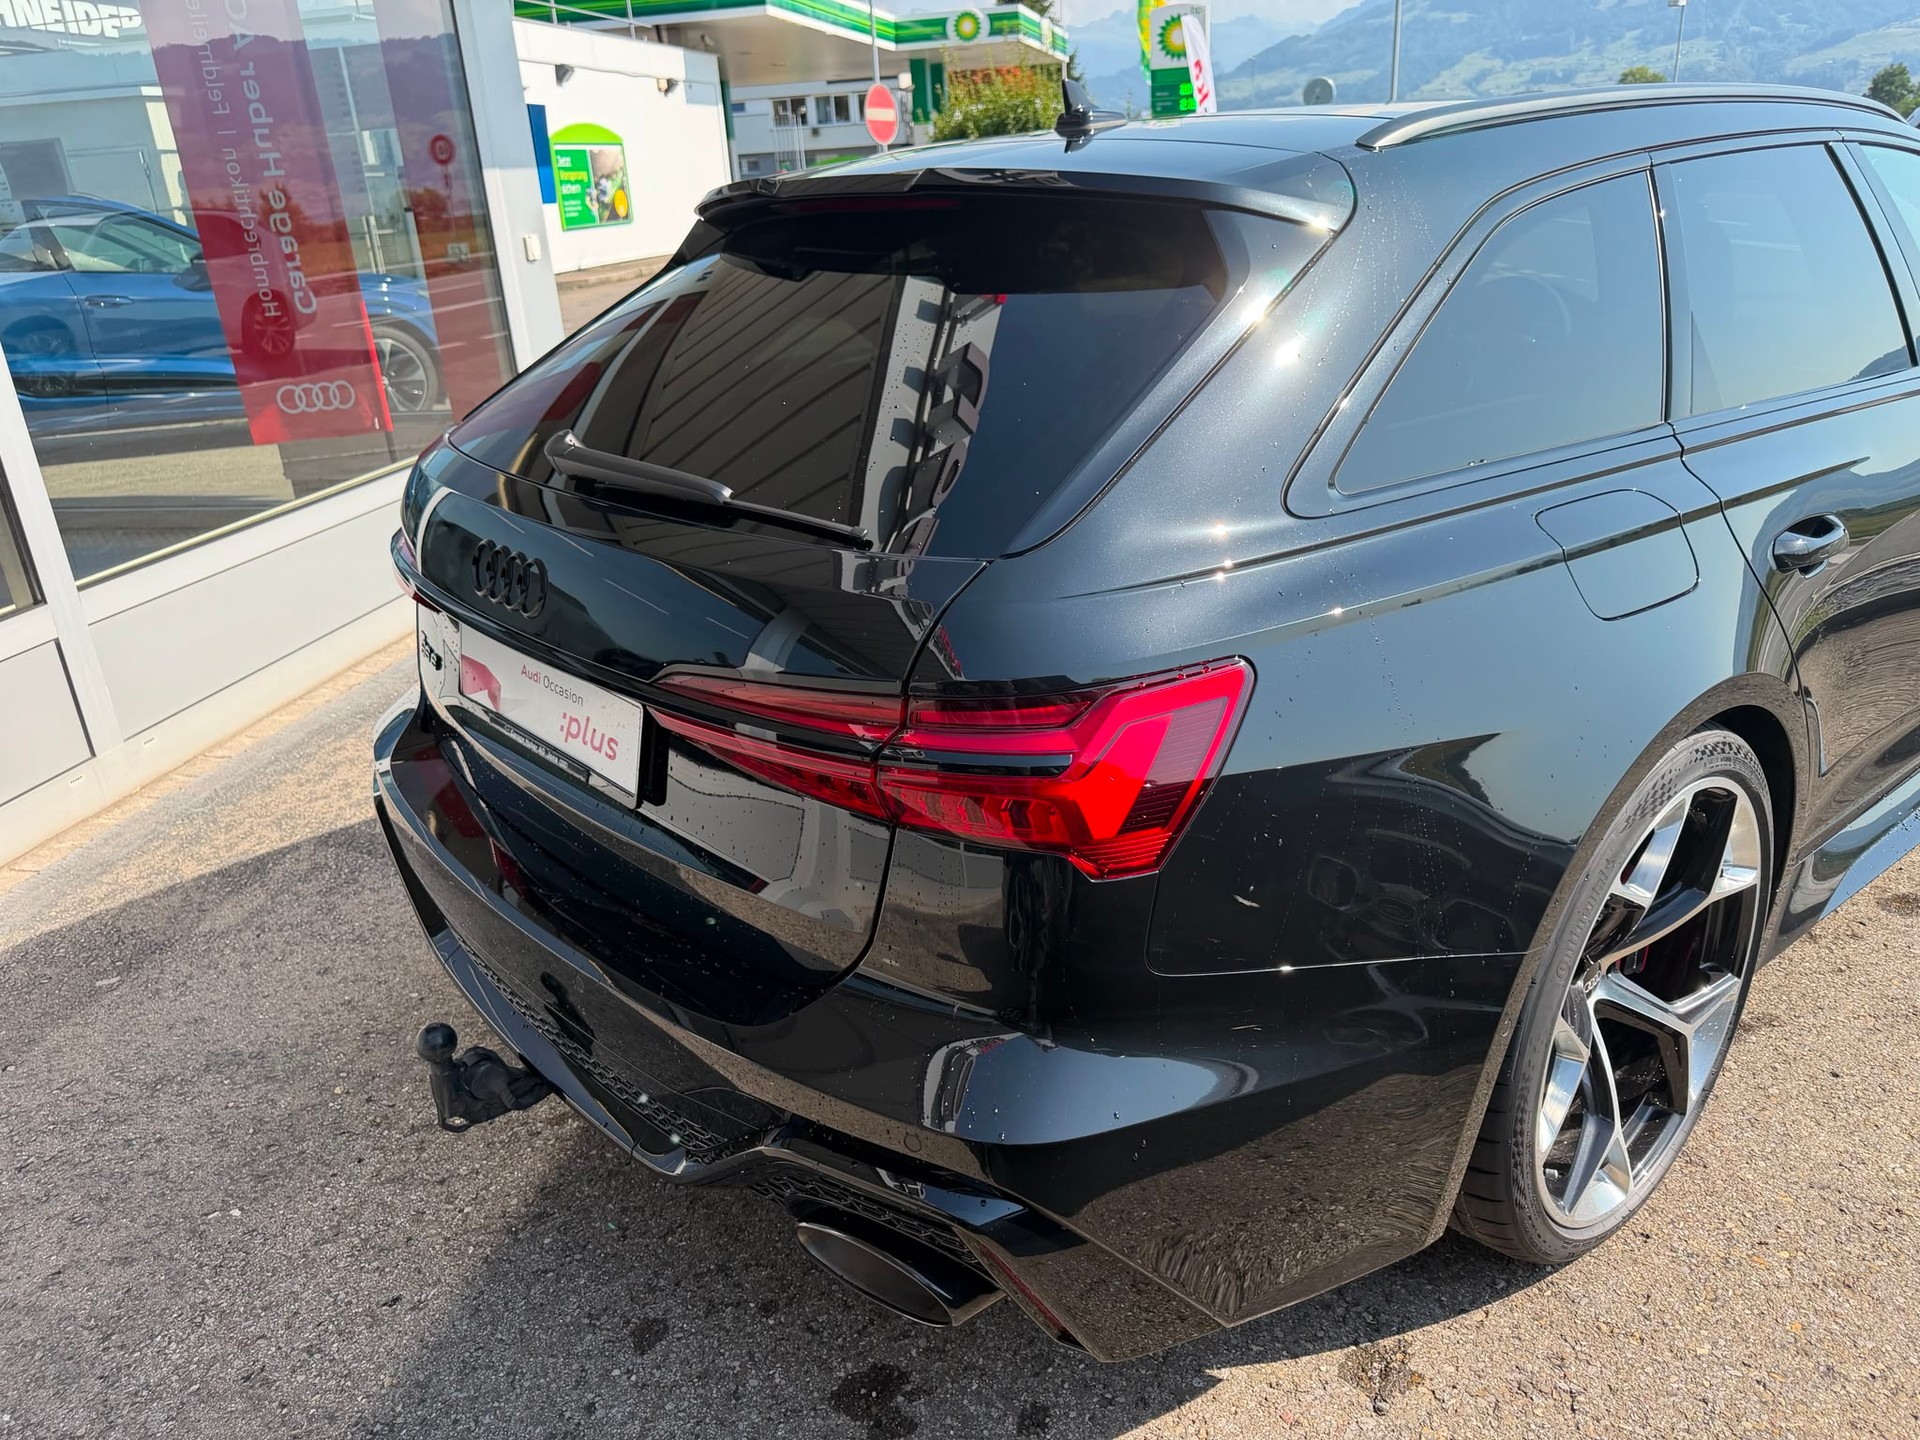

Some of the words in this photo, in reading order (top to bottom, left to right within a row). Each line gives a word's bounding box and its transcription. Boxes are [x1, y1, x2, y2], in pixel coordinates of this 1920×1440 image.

[520, 664, 541, 685] Audi
[543, 675, 584, 707] Occasion
[560, 711, 619, 761] :plus
